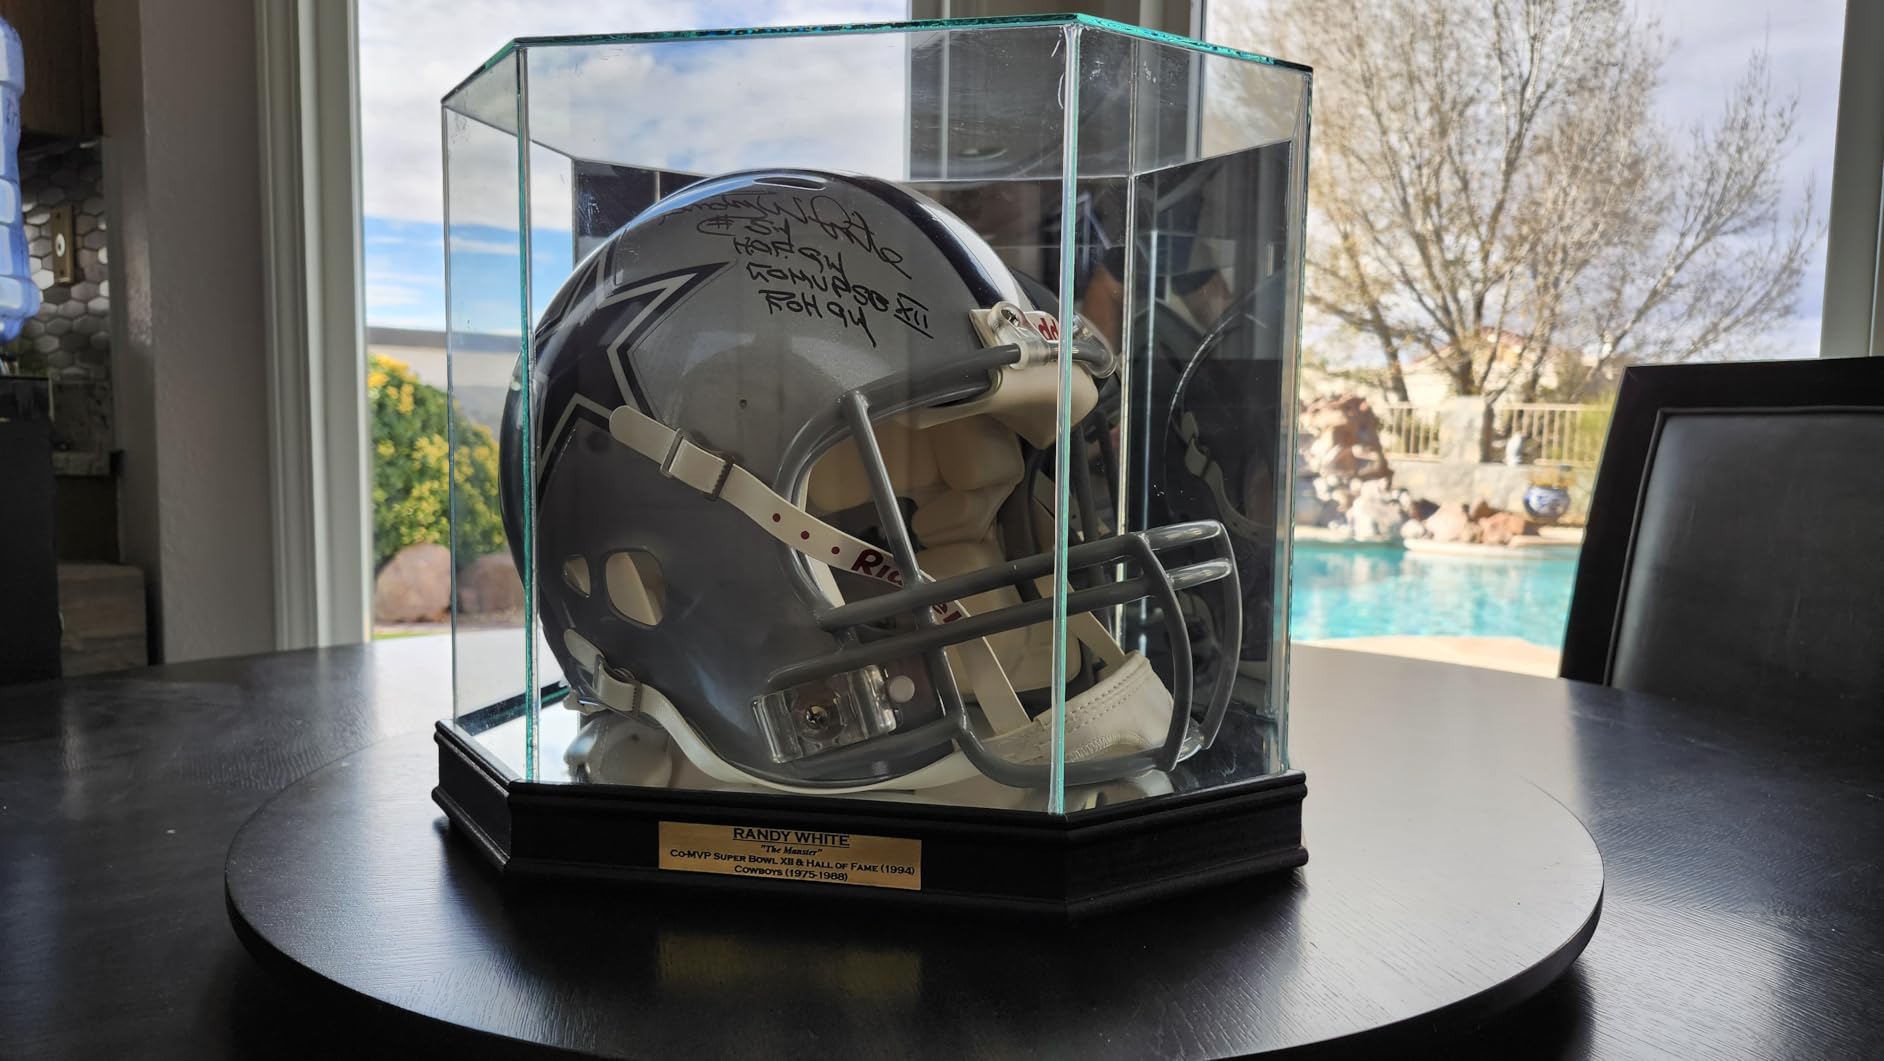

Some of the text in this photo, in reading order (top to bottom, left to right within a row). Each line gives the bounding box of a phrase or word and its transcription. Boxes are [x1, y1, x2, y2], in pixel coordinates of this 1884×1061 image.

[733, 827, 850, 847] RANDY WHITE
[780, 857, 793, 866] XII
[795, 858, 803, 866] &
[881, 864, 915, 876] (1994)
[785, 868, 848, 881] (1975-1988)
